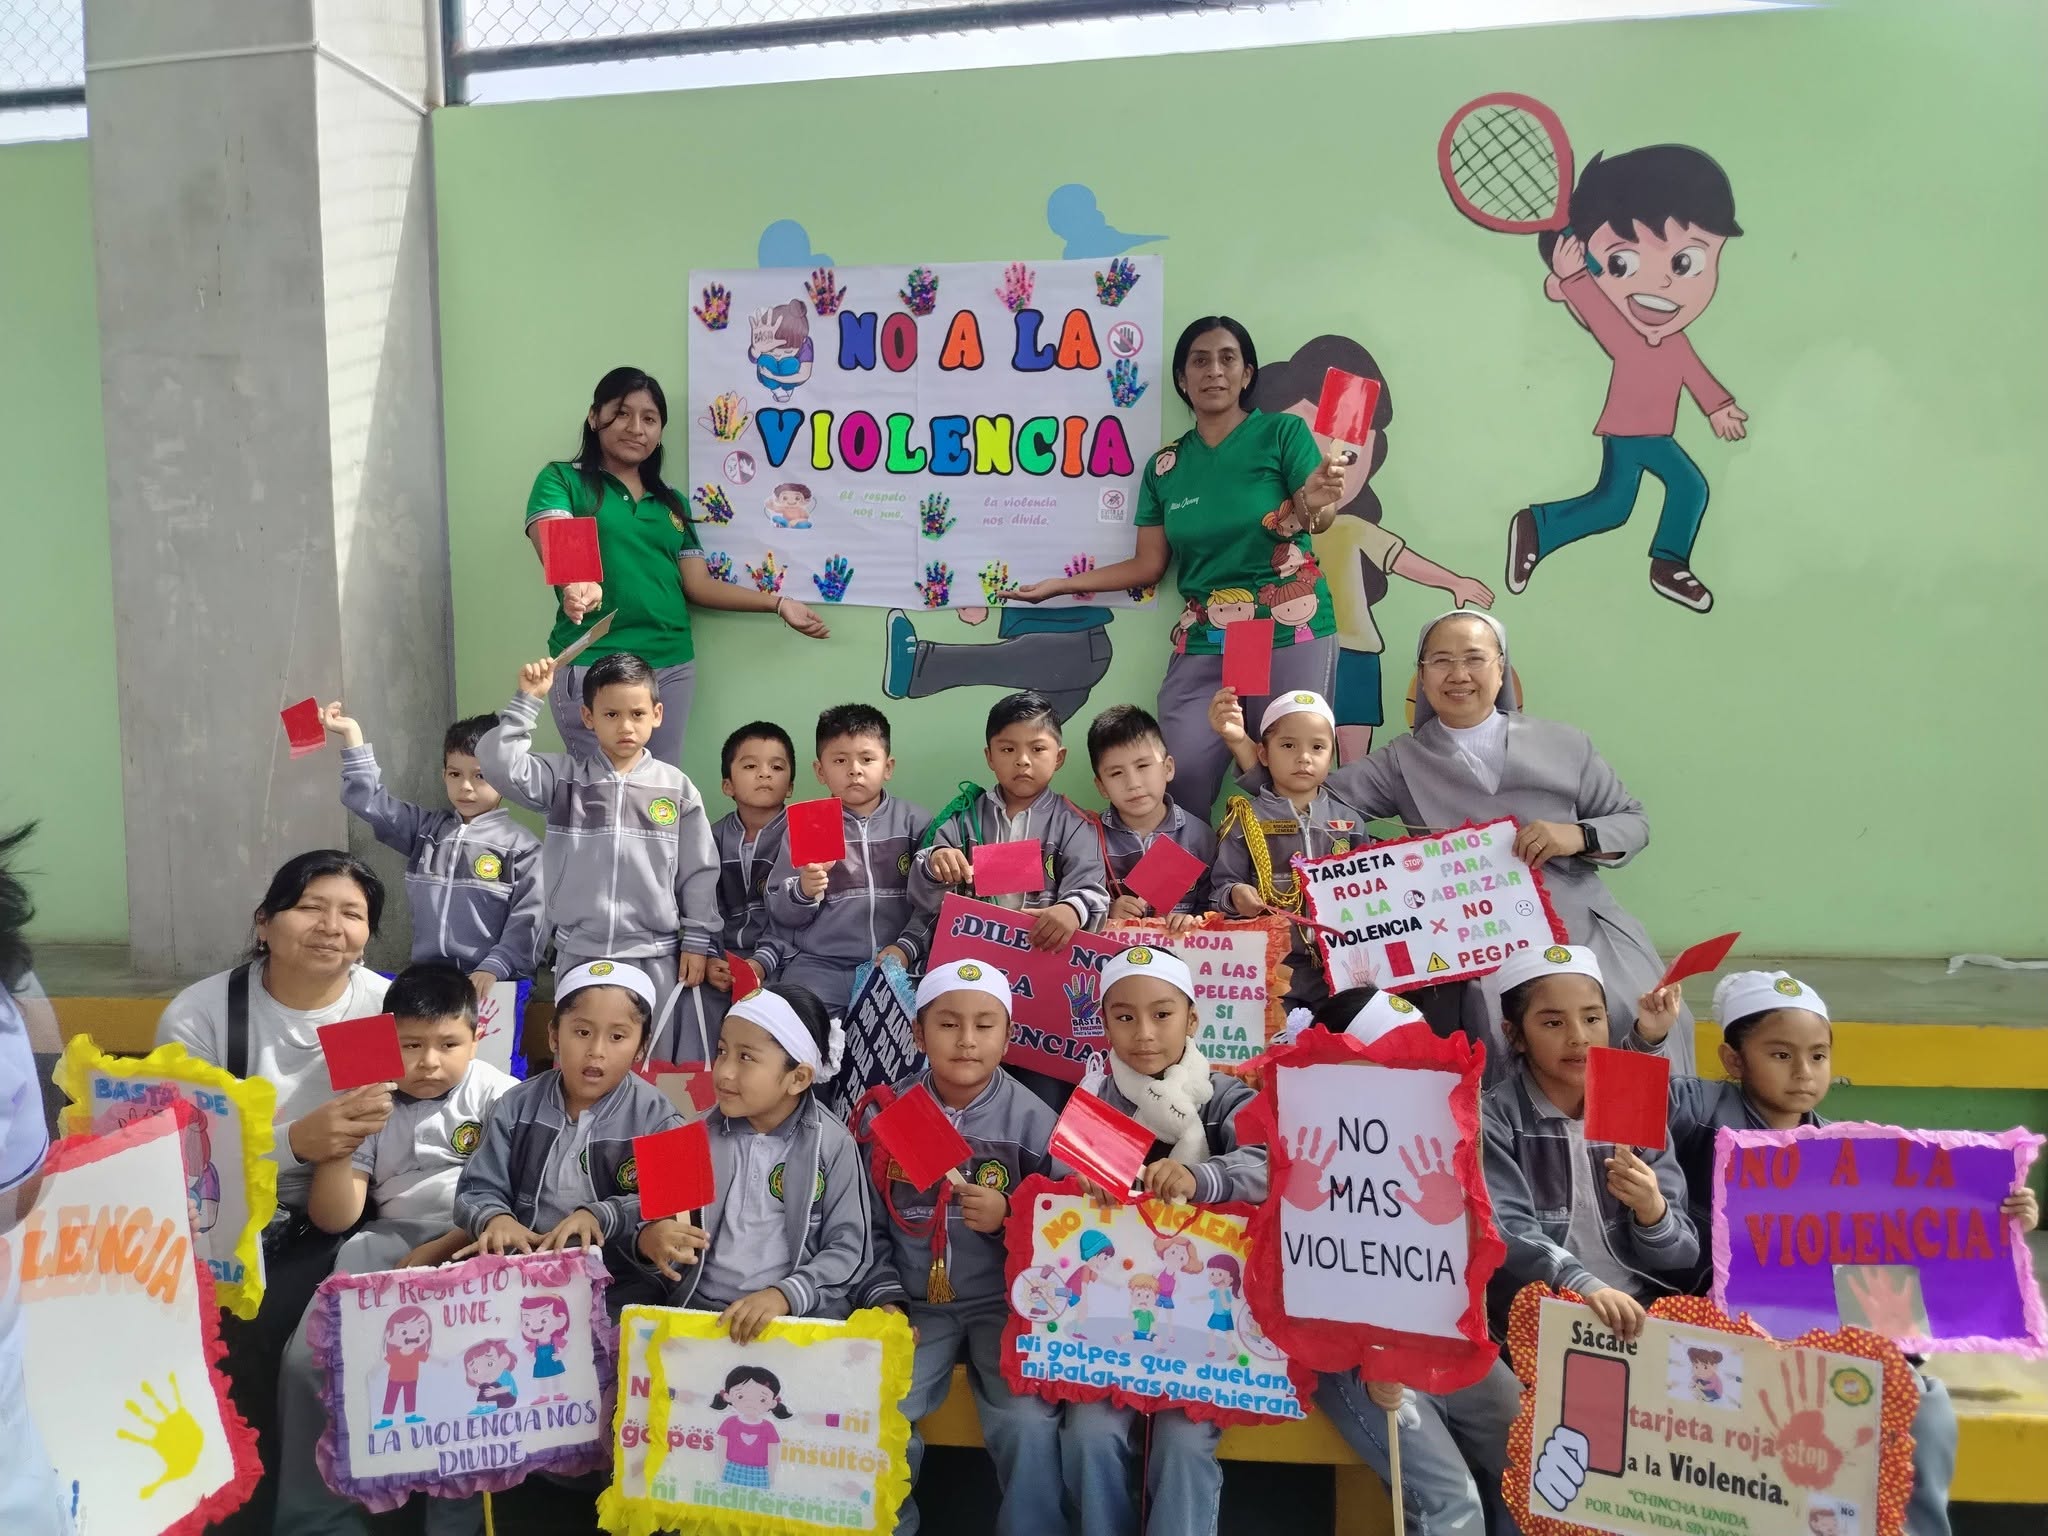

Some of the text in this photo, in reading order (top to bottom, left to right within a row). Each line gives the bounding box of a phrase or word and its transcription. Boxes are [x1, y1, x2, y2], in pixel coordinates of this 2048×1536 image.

[838, 308, 1102, 372] NO A LA
[755, 407, 1135, 478] VIOLENCIA
[1004, 497, 1057, 508] violencia
[1423, 832, 1492, 858] MANOS
[1308, 853, 1396, 883] TARJETA
[1404, 858, 1421, 868] STOP
[1440, 855, 1493, 878] PARA
[1333, 878, 1388, 900] ROJA
[1432, 871, 1522, 902] ABRAZAR
[1341, 899, 1392, 923] A LA
[1462, 899, 1493, 919] NO
[1184, 936, 1234, 951] ROJA
[1457, 919, 1512, 943] PARA
[1199, 962, 1258, 979] A LAS
[871, 974, 918, 1067] LAS MANOS
[1072, 1017, 1102, 1026] BASTA
[1215, 1004, 1234, 1020] SI
[859, 998, 901, 1082] SON PARA
[1203, 1025, 1247, 1042] A LA
[94, 1079, 228, 1115] BASTA DE
[1339, 1116, 1388, 1154] NO
[1830, 1138, 1860, 1186] A
[1892, 1138, 1957, 1188] LA
[1330, 1175, 1402, 1218] MAS
[1041, 1211, 1082, 1249] NO
[1145, 1202, 1254, 1252] VIOLEN
[20, 1206, 188, 1304] LENCIA
[1285, 1231, 1456, 1285] VIOLENCIA
[443, 1300, 500, 1328] UNE,
[1047, 1341, 1131, 1366] golpes
[1140, 1353, 1187, 1376] que
[1196, 1364, 1296, 1395] duelan,
[1166, 1380, 1212, 1399] que
[1215, 1389, 1305, 1418] hieran.
[368, 1400, 598, 1455] LA VIOLENCIA NOS
[621, 1424, 715, 1452] gopes
[843, 1411, 870, 1434] ni
[1629, 1402, 1776, 1458] tarjeta roja
[438, 1441, 525, 1476] DIVIDE
[781, 1441, 889, 1473] insultos
[1787, 1440, 1828, 1473] stop
[1628, 1452, 1790, 1507] a la Violencia.
[651, 1482, 863, 1527] ni indiferencia
[1585, 1497, 1612, 1514] POR
[1615, 1504, 1646, 1522] UNA
[1649, 1512, 1682, 1531] VIDA
[1686, 1521, 1706, 1536] SIN
[1702, 1507, 1748, 1529] UNIDA
